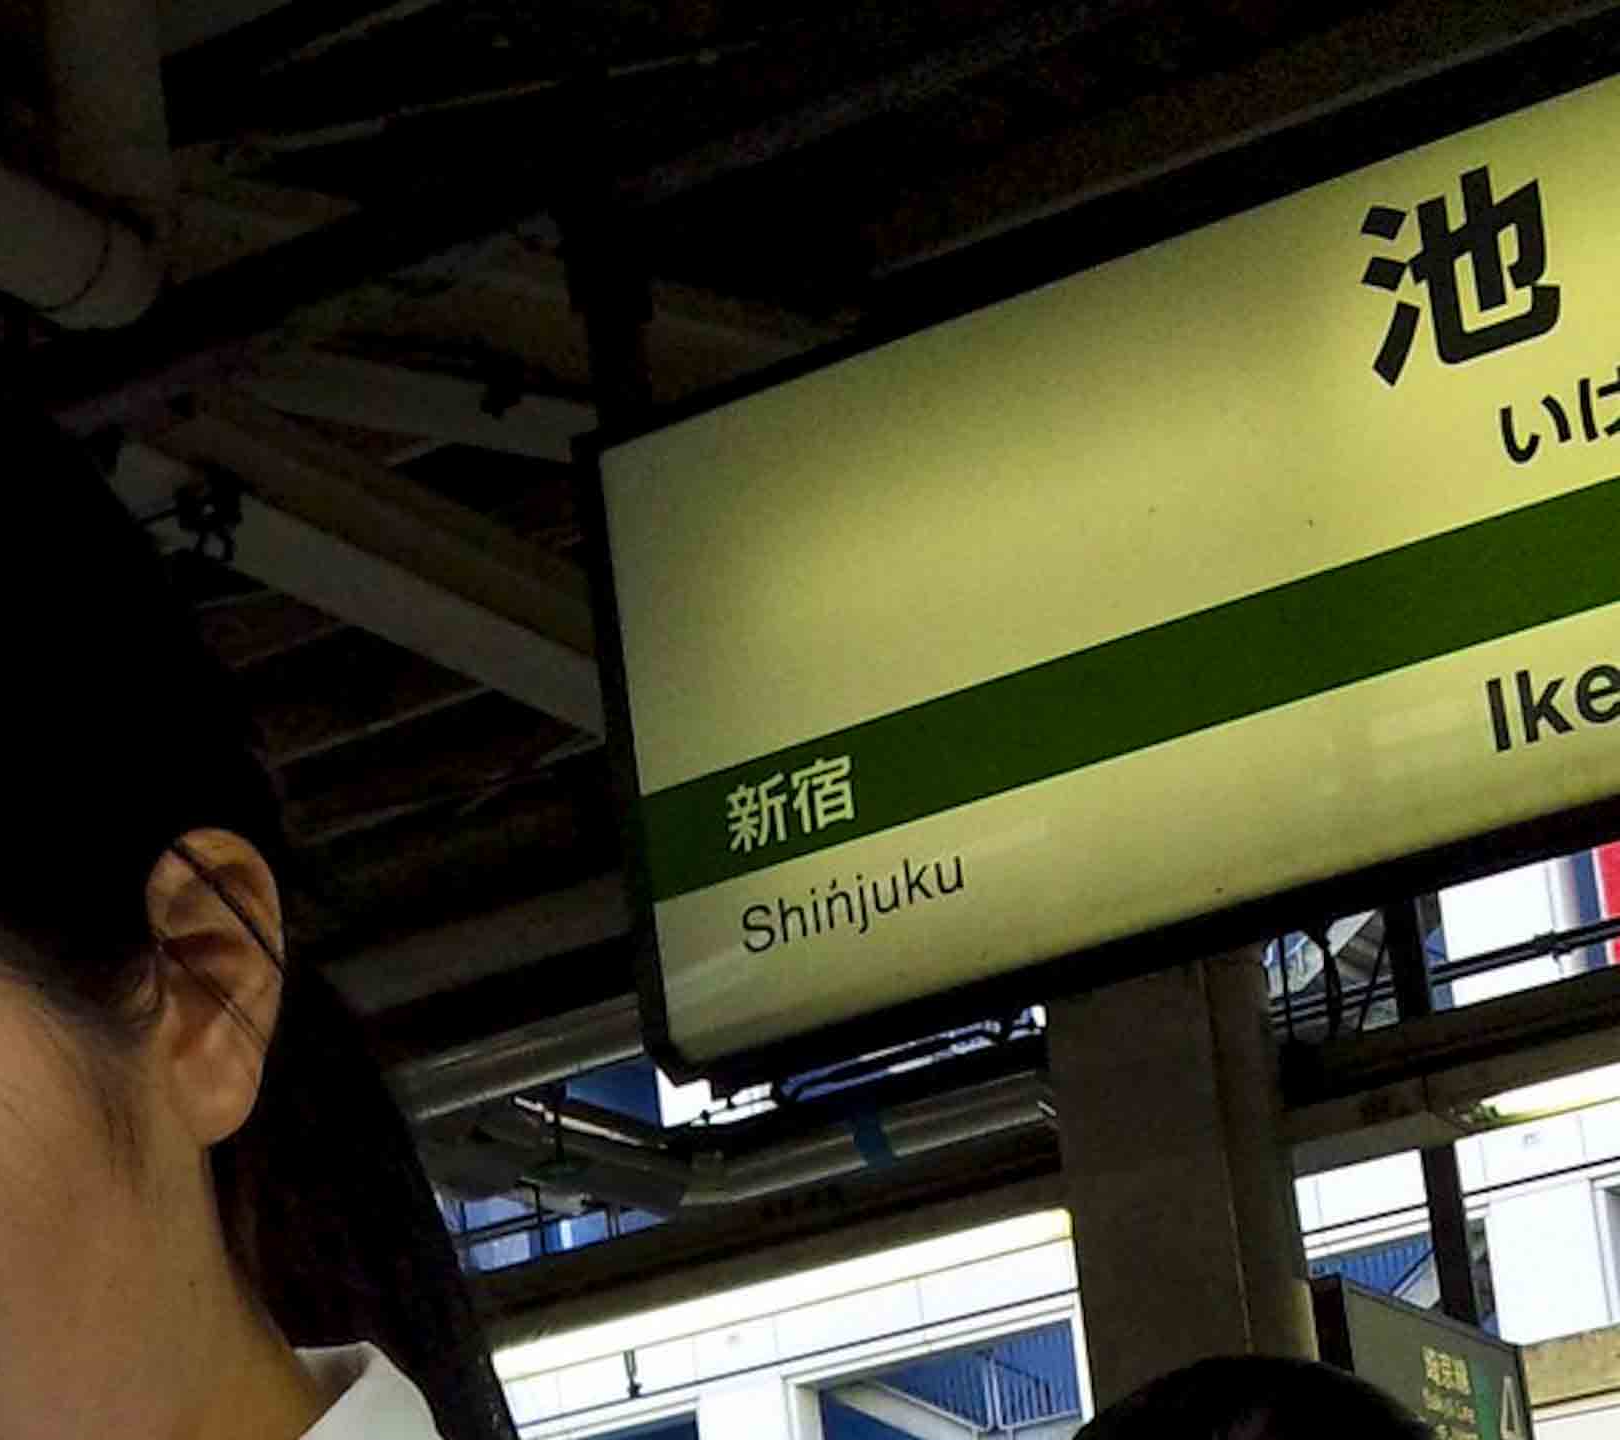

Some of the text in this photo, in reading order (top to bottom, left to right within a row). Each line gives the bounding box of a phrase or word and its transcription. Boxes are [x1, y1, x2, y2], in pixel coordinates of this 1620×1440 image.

[1360, 166, 1560, 387] 池
[1486, 664, 1620, 752] Ike
[726, 755, 855, 852] 新宿
[742, 856, 965, 952] Shinjuku
